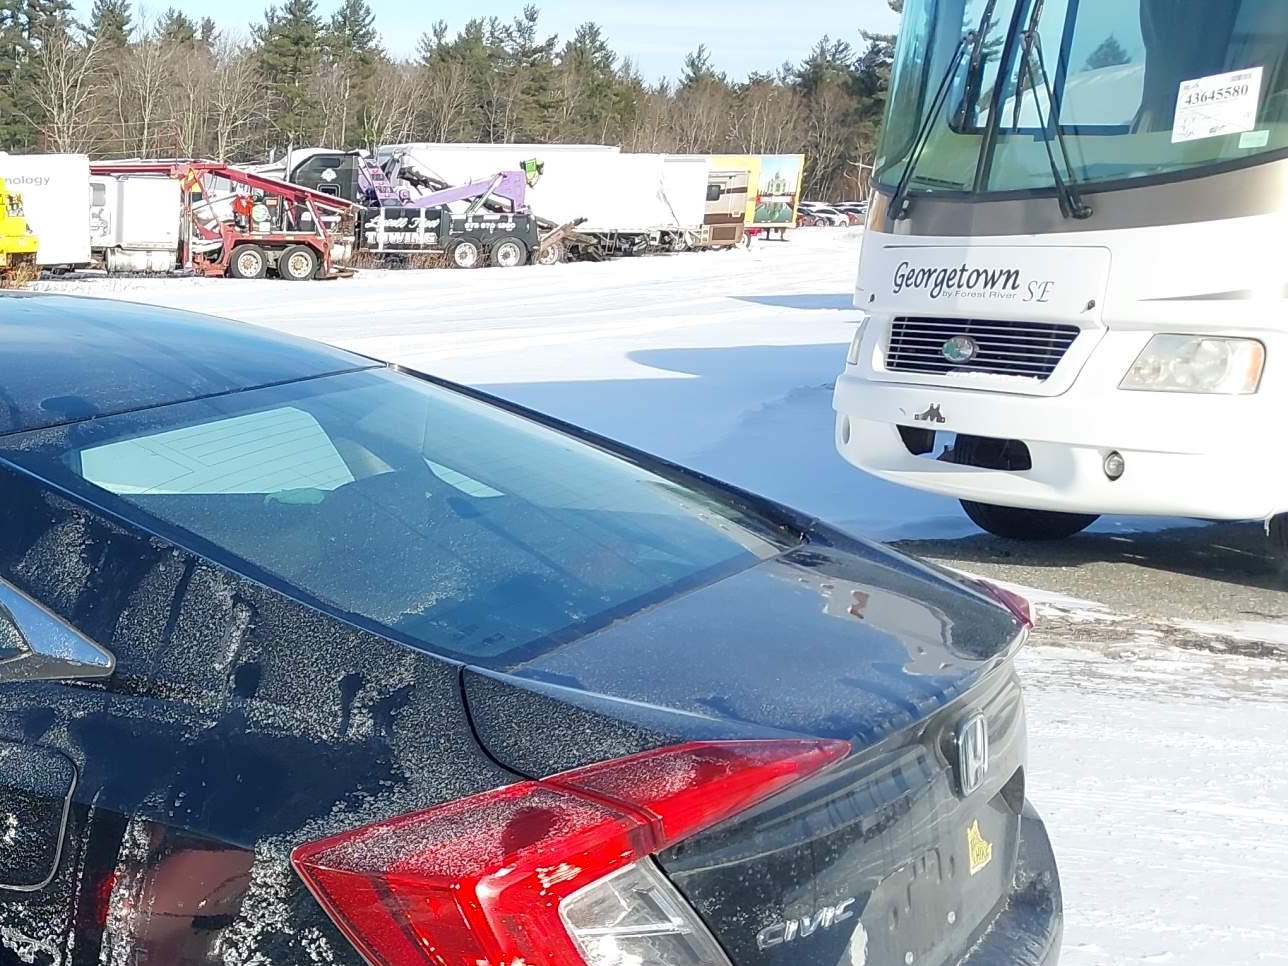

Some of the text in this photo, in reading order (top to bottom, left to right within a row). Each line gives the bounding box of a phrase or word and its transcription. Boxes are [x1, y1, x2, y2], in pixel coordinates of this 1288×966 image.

[1185, 84, 1249, 105] 43645580
[893, 261, 1020, 299] Georgetown
[942, 289, 1017, 299] by Forest River
[756, 897, 856, 950] CIVIC
